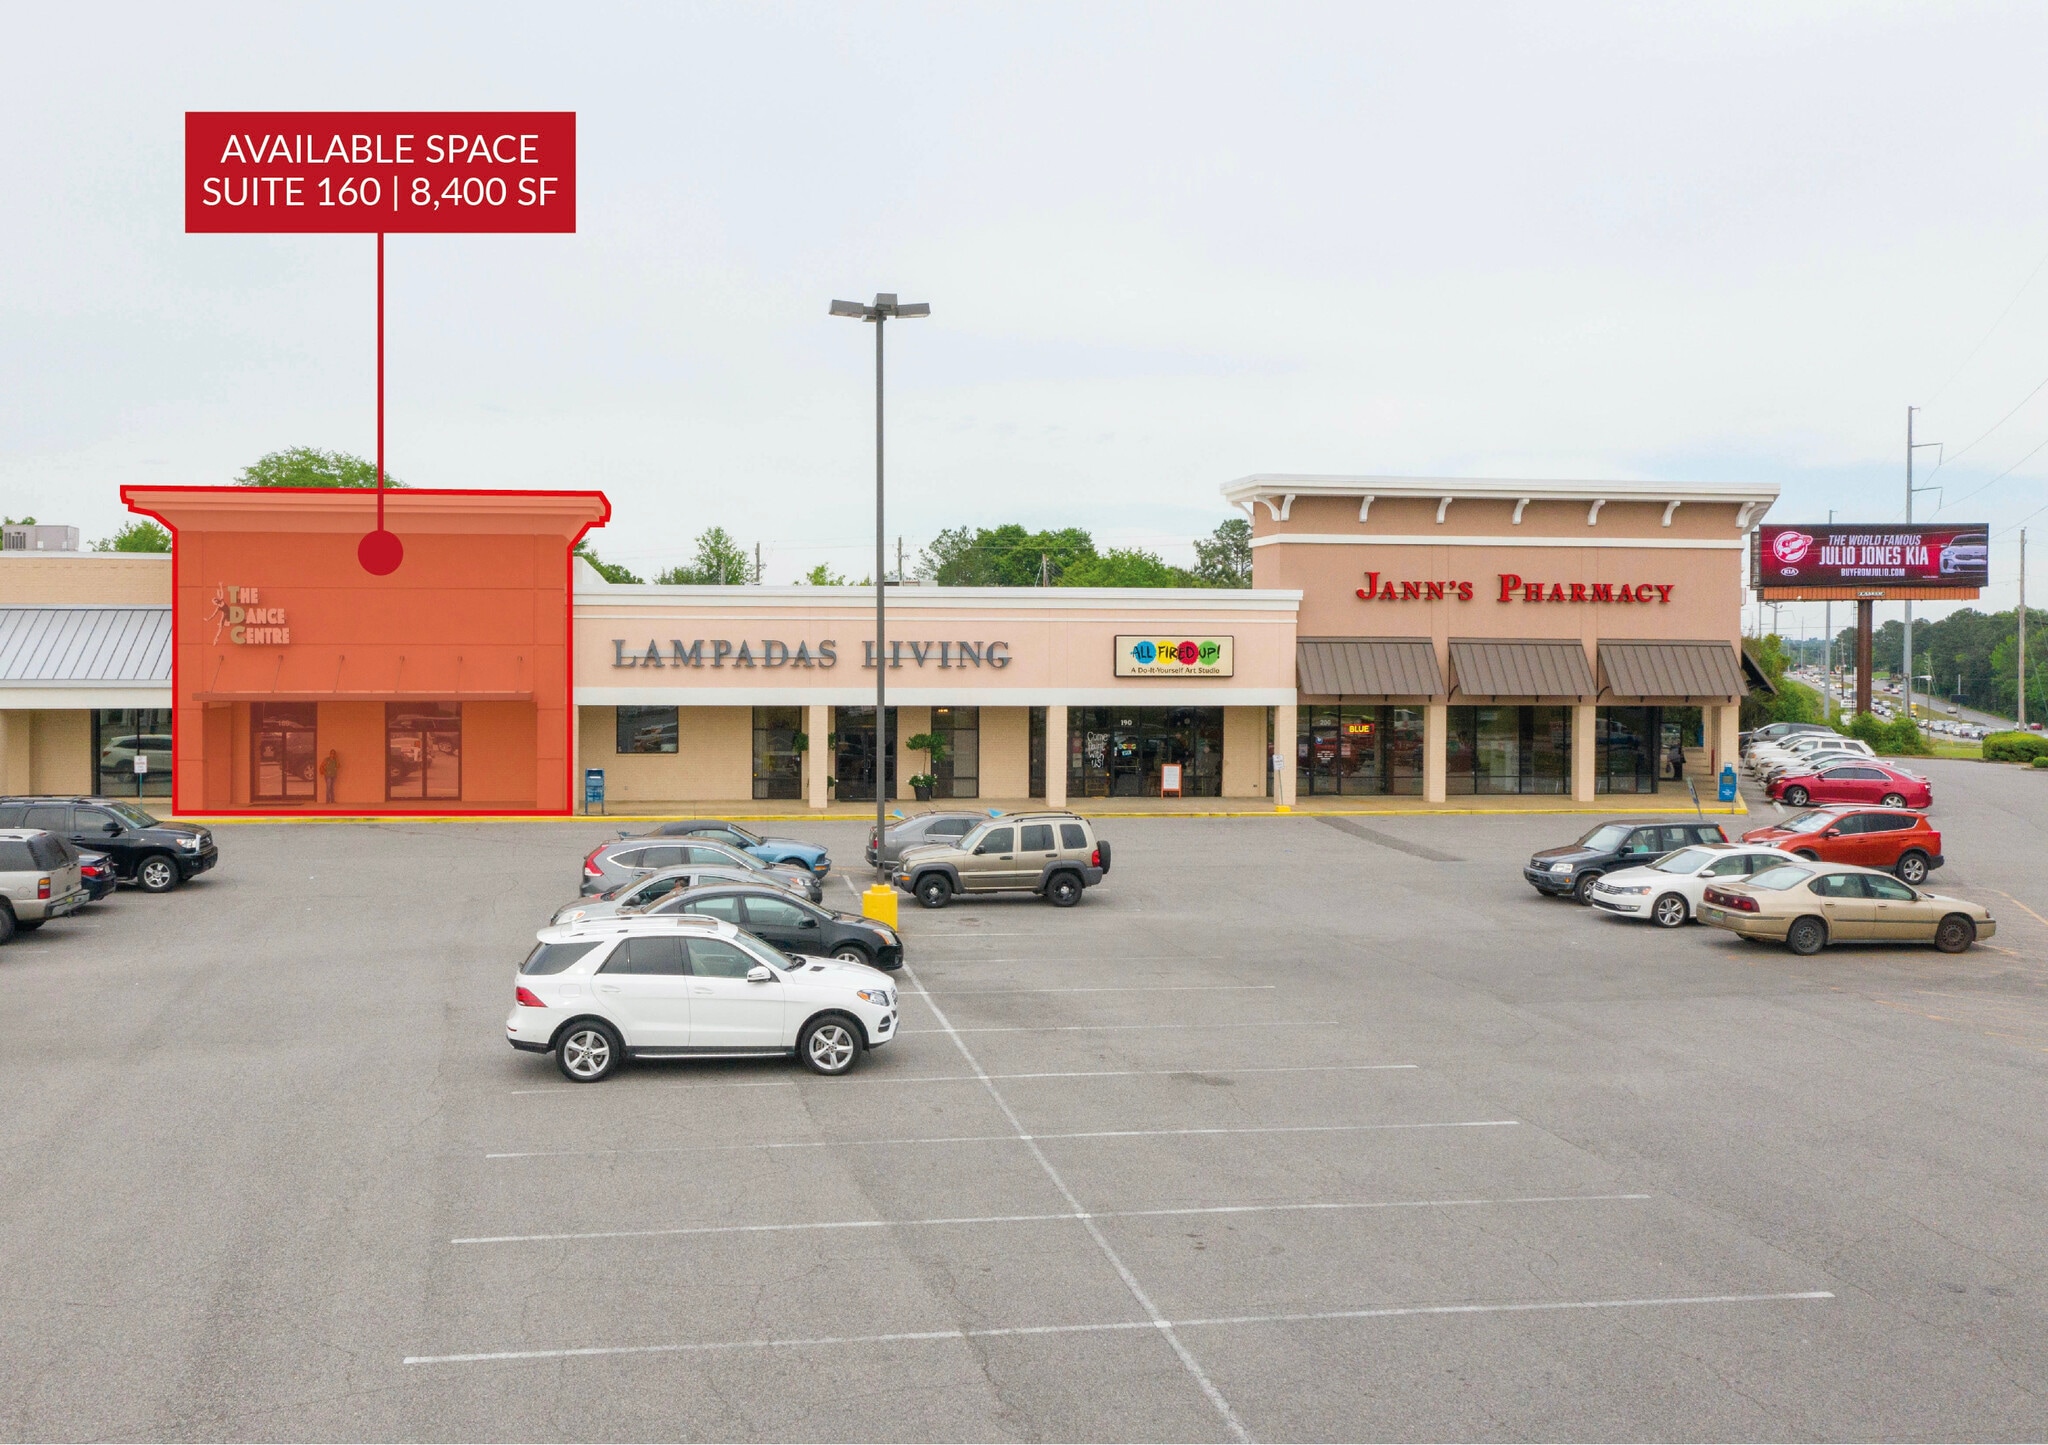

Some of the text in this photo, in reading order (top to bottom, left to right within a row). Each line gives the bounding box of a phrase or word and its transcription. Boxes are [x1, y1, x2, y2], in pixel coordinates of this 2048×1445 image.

[1828, 535, 1922, 546] THE WORLD FAMOUS
[1819, 546, 1929, 565] JULIO JONES KIA
[1841, 568, 1905, 577] BUYFROMJULIO.COM
[227, 585, 259, 604] THE
[1497, 573, 1676, 603] PHARMACY
[230, 606, 286, 625] DANCE
[230, 625, 290, 645] CENTRE
[611, 639, 1013, 669] LAMPADAS LIVING
[1130, 644, 1221, 661] ALL FIRED UP!
[1349, 725, 1370, 733] BLUE
